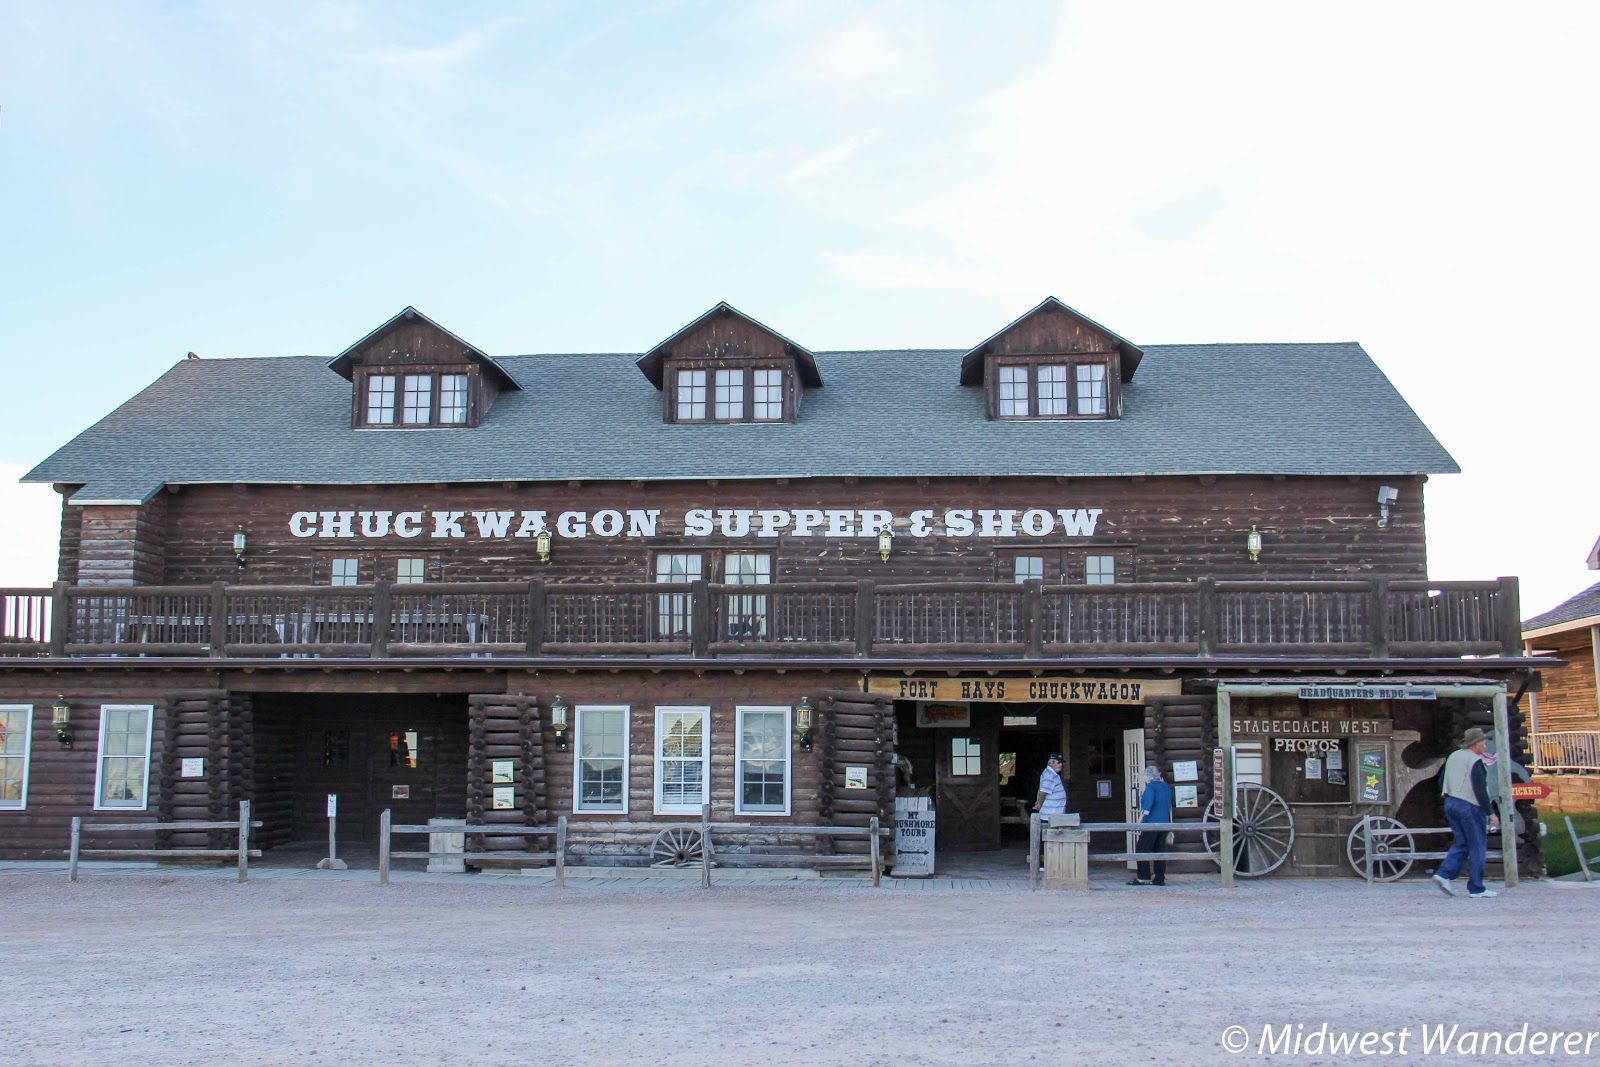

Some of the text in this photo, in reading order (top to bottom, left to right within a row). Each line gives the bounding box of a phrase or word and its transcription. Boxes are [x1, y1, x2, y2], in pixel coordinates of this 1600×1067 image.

[287, 508, 1102, 538] CHUCKWAGON SUPPER & SHOW
[900, 680, 1141, 701] FORT HAYS CHUCKWAGON
[1300, 687, 1404, 698] HEADQUARTERS BLDG
[1233, 719, 1379, 733] STAGECOACH WEST
[1274, 738, 1339, 752] PHOTOS
[907, 811, 919, 819] MT
[895, 820, 935, 828] RUSHMORE
[900, 828, 927, 837] TOURS
